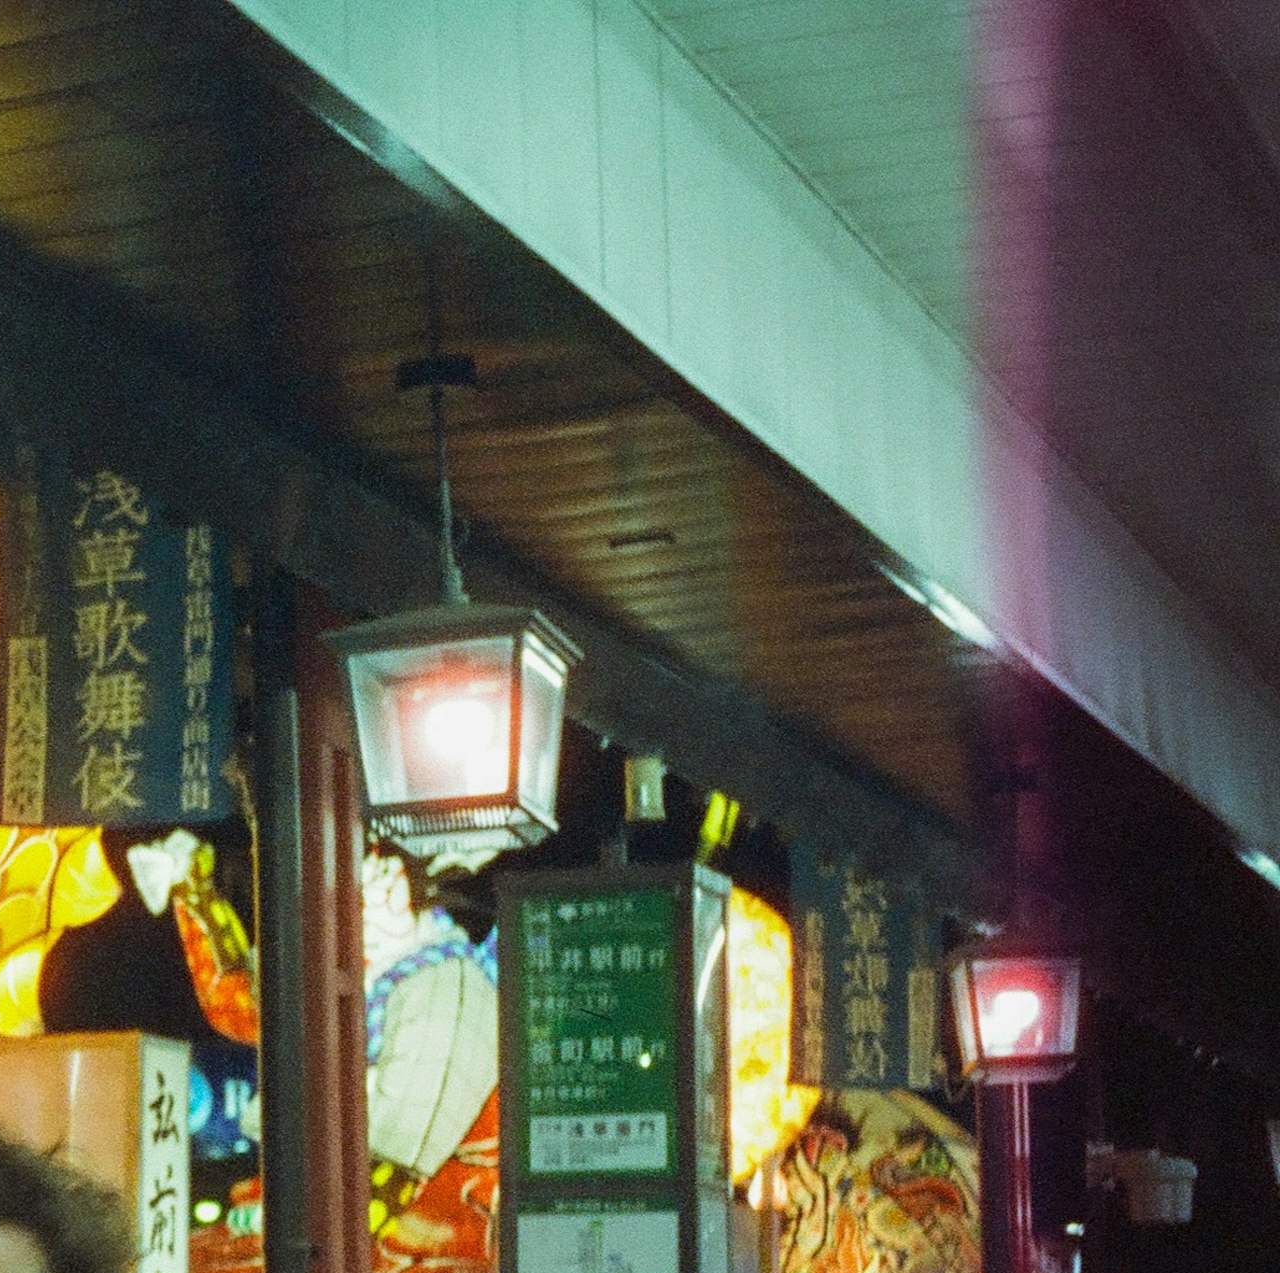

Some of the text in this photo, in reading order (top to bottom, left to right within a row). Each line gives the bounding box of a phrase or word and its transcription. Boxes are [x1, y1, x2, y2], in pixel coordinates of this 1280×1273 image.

[72, 470, 149, 814] 浅草歌舞伎
